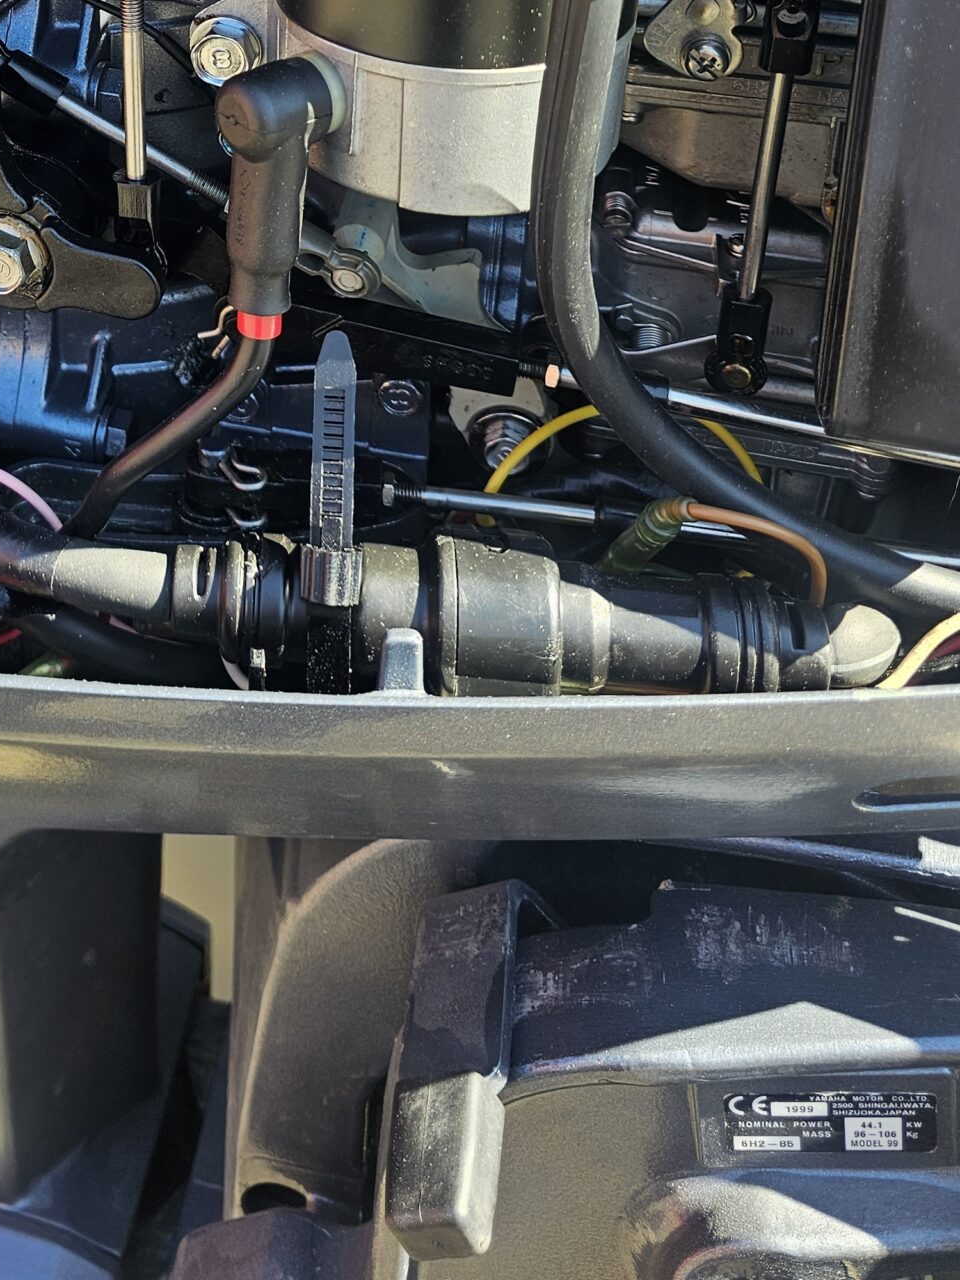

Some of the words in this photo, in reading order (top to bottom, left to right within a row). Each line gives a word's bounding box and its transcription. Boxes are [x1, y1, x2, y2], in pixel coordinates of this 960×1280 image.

[728, 1095, 768, 1116] CE
[802, 1130, 832, 1138] MASS
[906, 1131, 919, 1139] Kg
